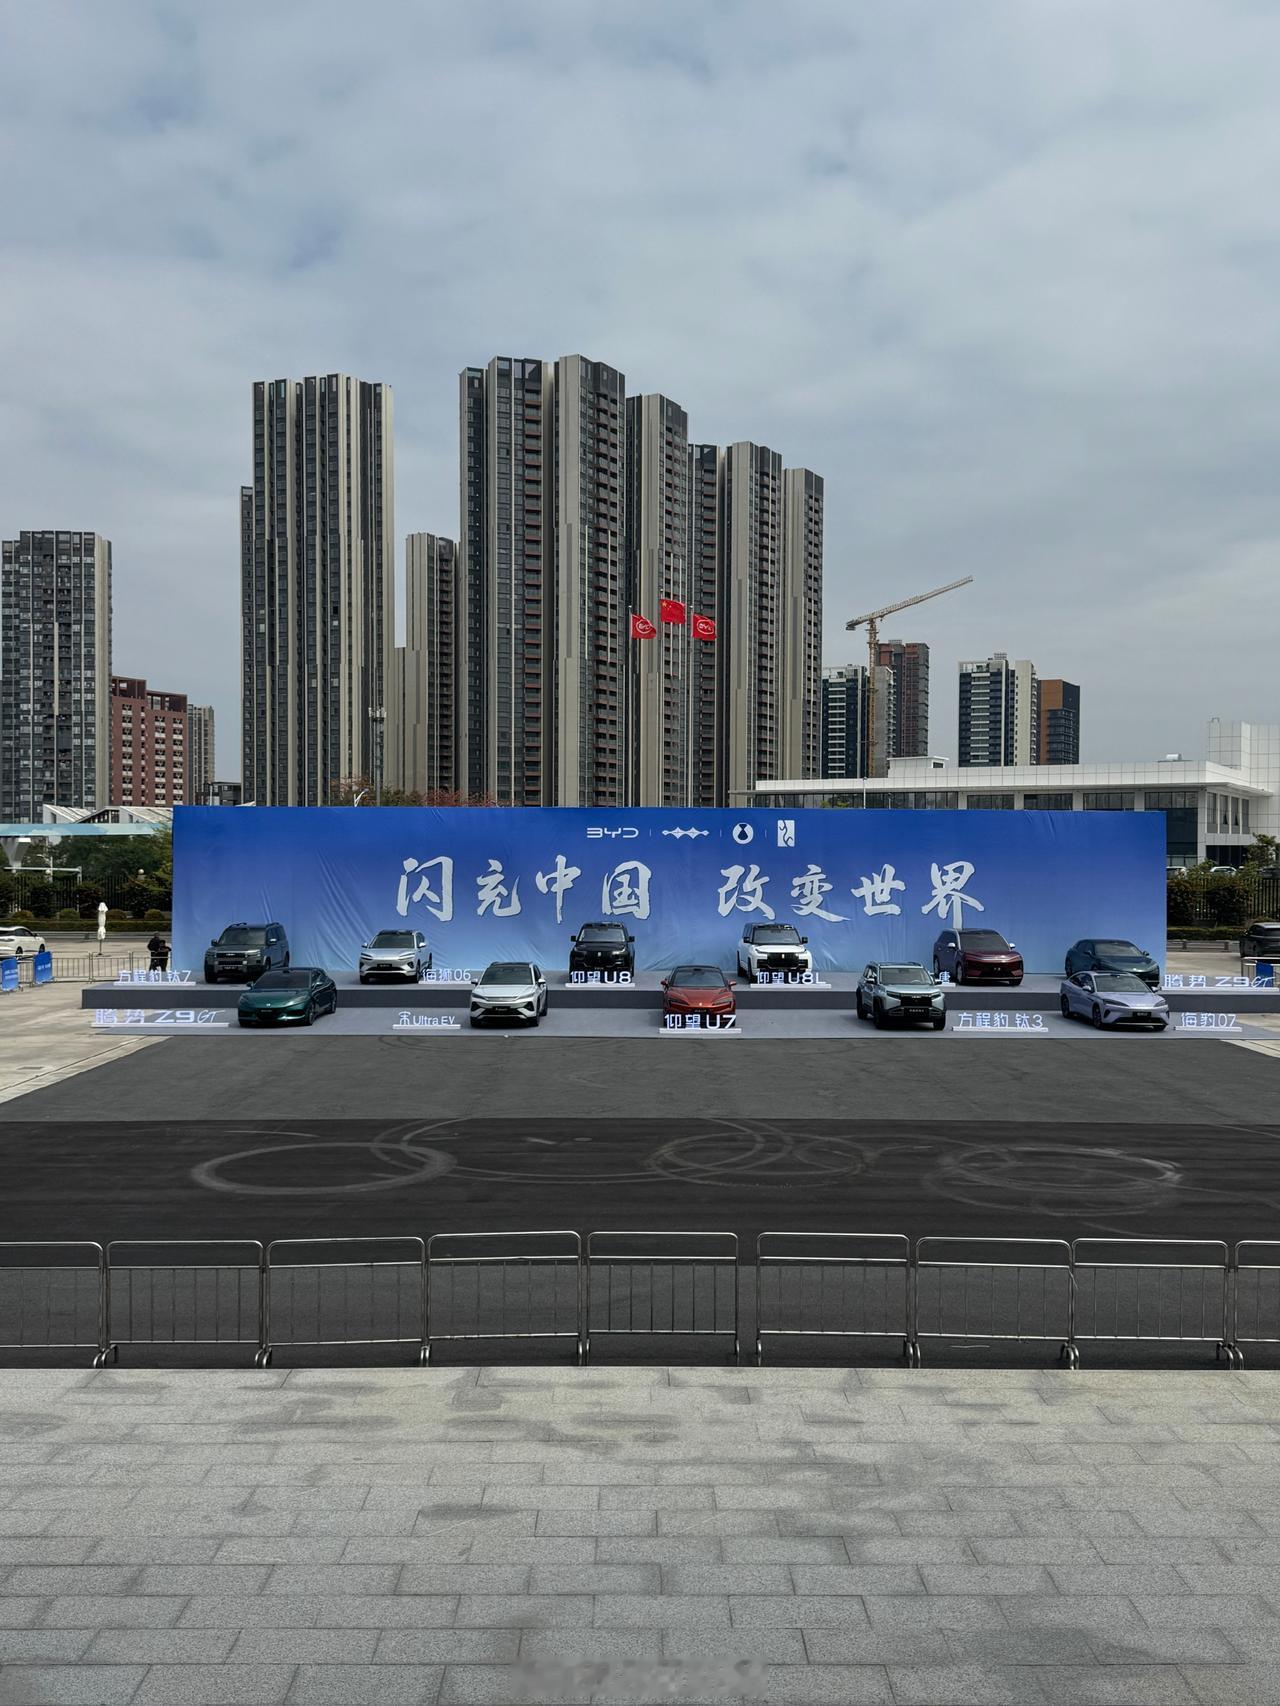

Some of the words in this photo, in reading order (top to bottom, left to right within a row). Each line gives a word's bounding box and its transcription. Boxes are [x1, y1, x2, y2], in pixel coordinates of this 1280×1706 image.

[586, 827, 639, 839] BYD
[395, 854, 651, 925] 闪充中国
[716, 862, 985, 929] 改变世界
[119, 969, 163, 983] 方程豹
[570, 971, 601, 984] 仰望
[604, 971, 632, 984] U8
[755, 972, 785, 985] 仰望
[788, 972, 826, 985] U8L
[1164, 974, 1207, 988] 腾势
[95, 1008, 145, 1023] 腾势
[441, 1016, 456, 1025] EV
[664, 1014, 701, 1029] 仰望
[706, 1014, 737, 1029] U7
[958, 1012, 1009, 1028] 方程豹
[1015, 1013, 1044, 1028] 钛3
[1181, 1012, 1237, 1027] 海豹07
